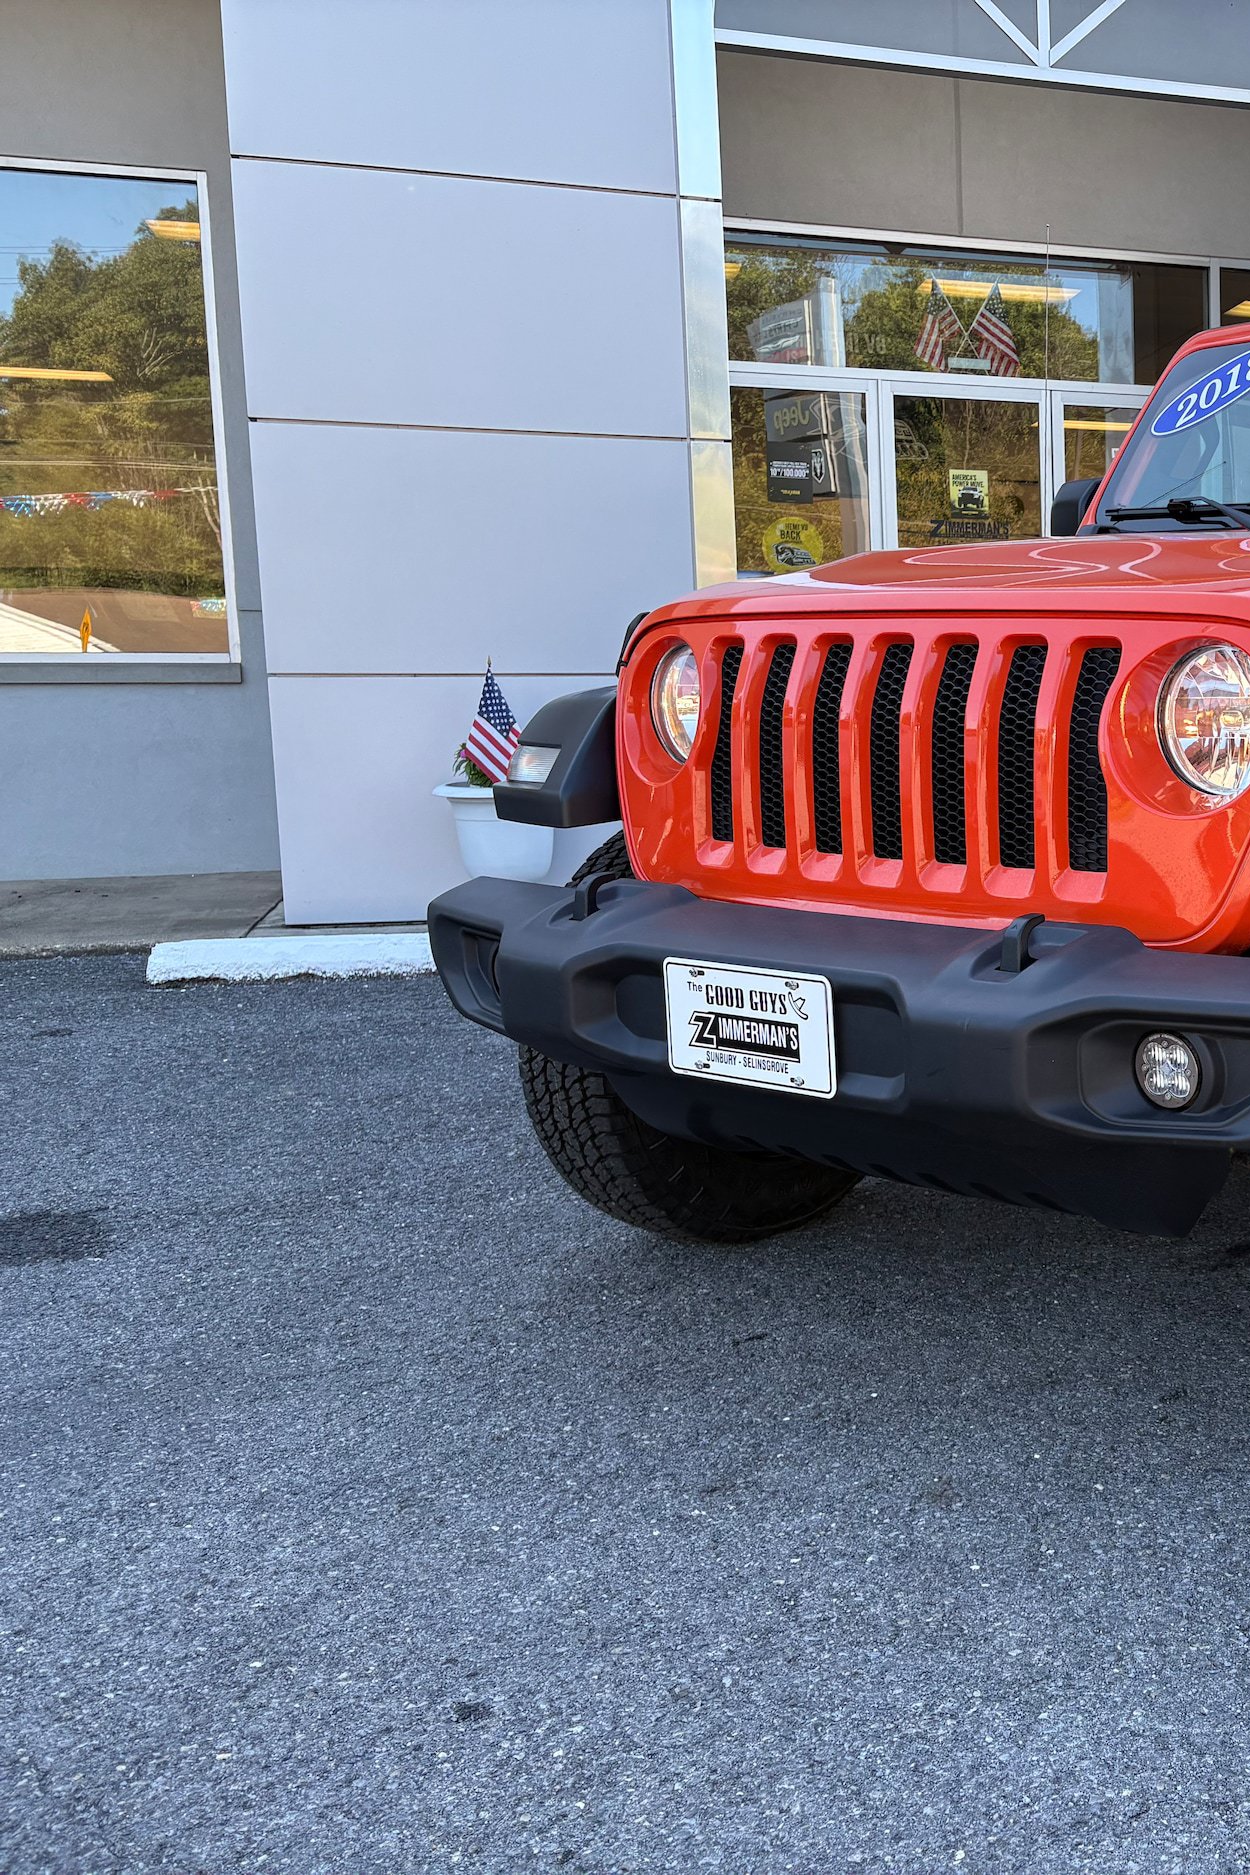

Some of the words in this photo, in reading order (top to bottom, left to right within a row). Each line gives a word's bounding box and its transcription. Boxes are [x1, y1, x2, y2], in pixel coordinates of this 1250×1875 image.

[780, 530, 801, 541] BACK
[930, 519, 1009, 537] ZIMMERMAN'S
[687, 981, 703, 992] The
[705, 984, 745, 1009] GOOD
[750, 989, 788, 1015] GUYS
[688, 1010, 799, 1051] ZIMMERMAN'S
[706, 1050, 737, 1066] SUNBURY
[743, 1056, 789, 1074] SELINSGROVE
